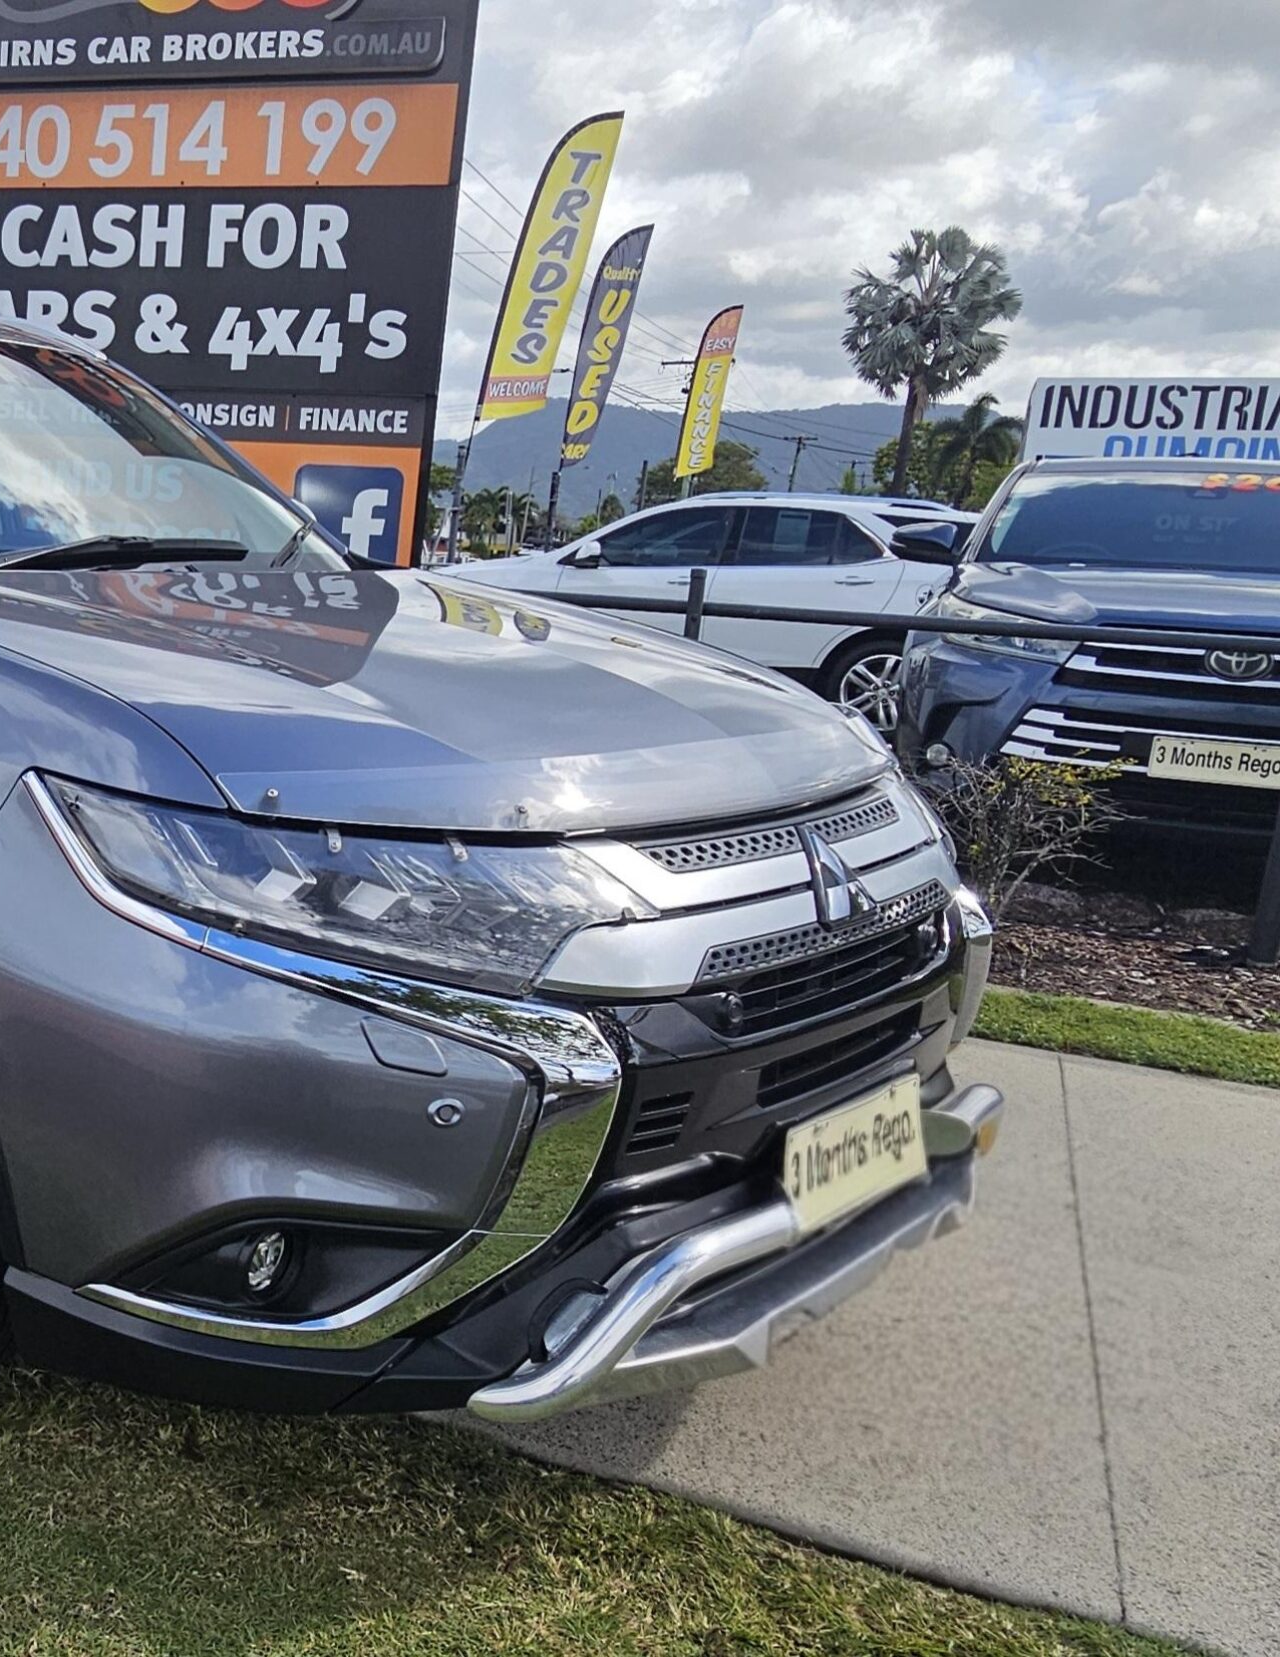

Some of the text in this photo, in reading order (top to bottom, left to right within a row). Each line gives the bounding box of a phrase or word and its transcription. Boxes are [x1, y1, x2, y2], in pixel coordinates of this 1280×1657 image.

[87, 36, 151, 65] CAR
[88, 100, 228, 178] 514
[257, 97, 397, 176] 199
[1, 203, 350, 269] CASH FOR
[510, 150, 602, 365] TRADES
[134, 293, 190, 354] &
[705, 336, 736, 351] EASY
[489, 379, 547, 398] WELCOME
[566, 288, 631, 435] USED
[179, 402, 408, 435] ONSIGN FINANCE
[688, 362, 723, 469] FINANCE
[1155, 745, 1166, 764] 3
[1170, 746, 1233, 770] Months
[791, 1150, 800, 1198] 3
[806, 1126, 868, 1192] Months
